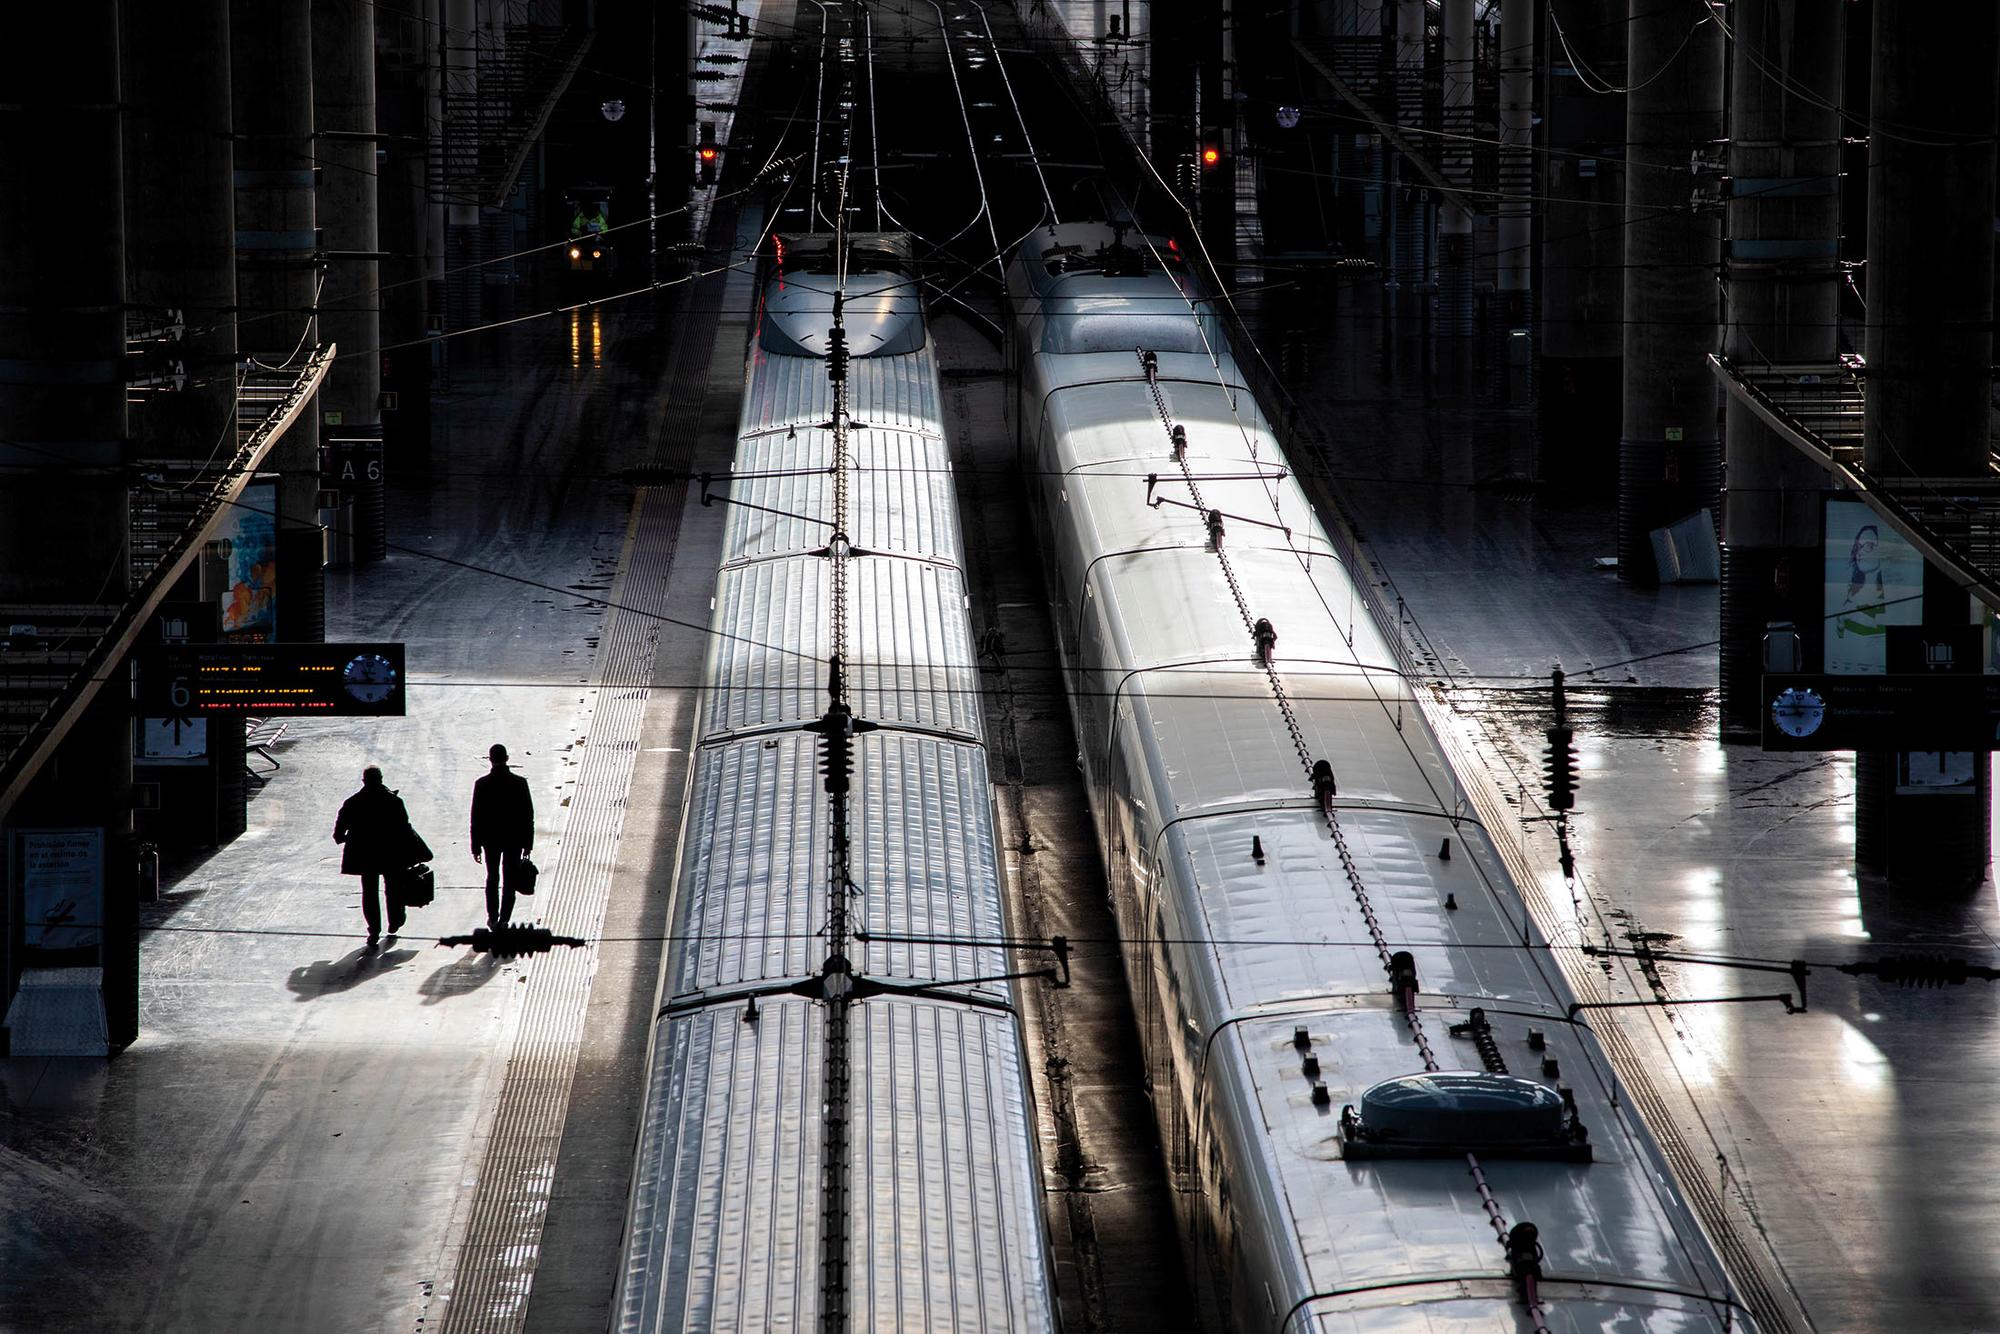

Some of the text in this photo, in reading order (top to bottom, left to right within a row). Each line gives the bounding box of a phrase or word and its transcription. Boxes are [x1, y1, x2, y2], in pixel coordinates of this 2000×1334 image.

[341, 460, 380, 480] A 6
[171, 676, 191, 707] 6
